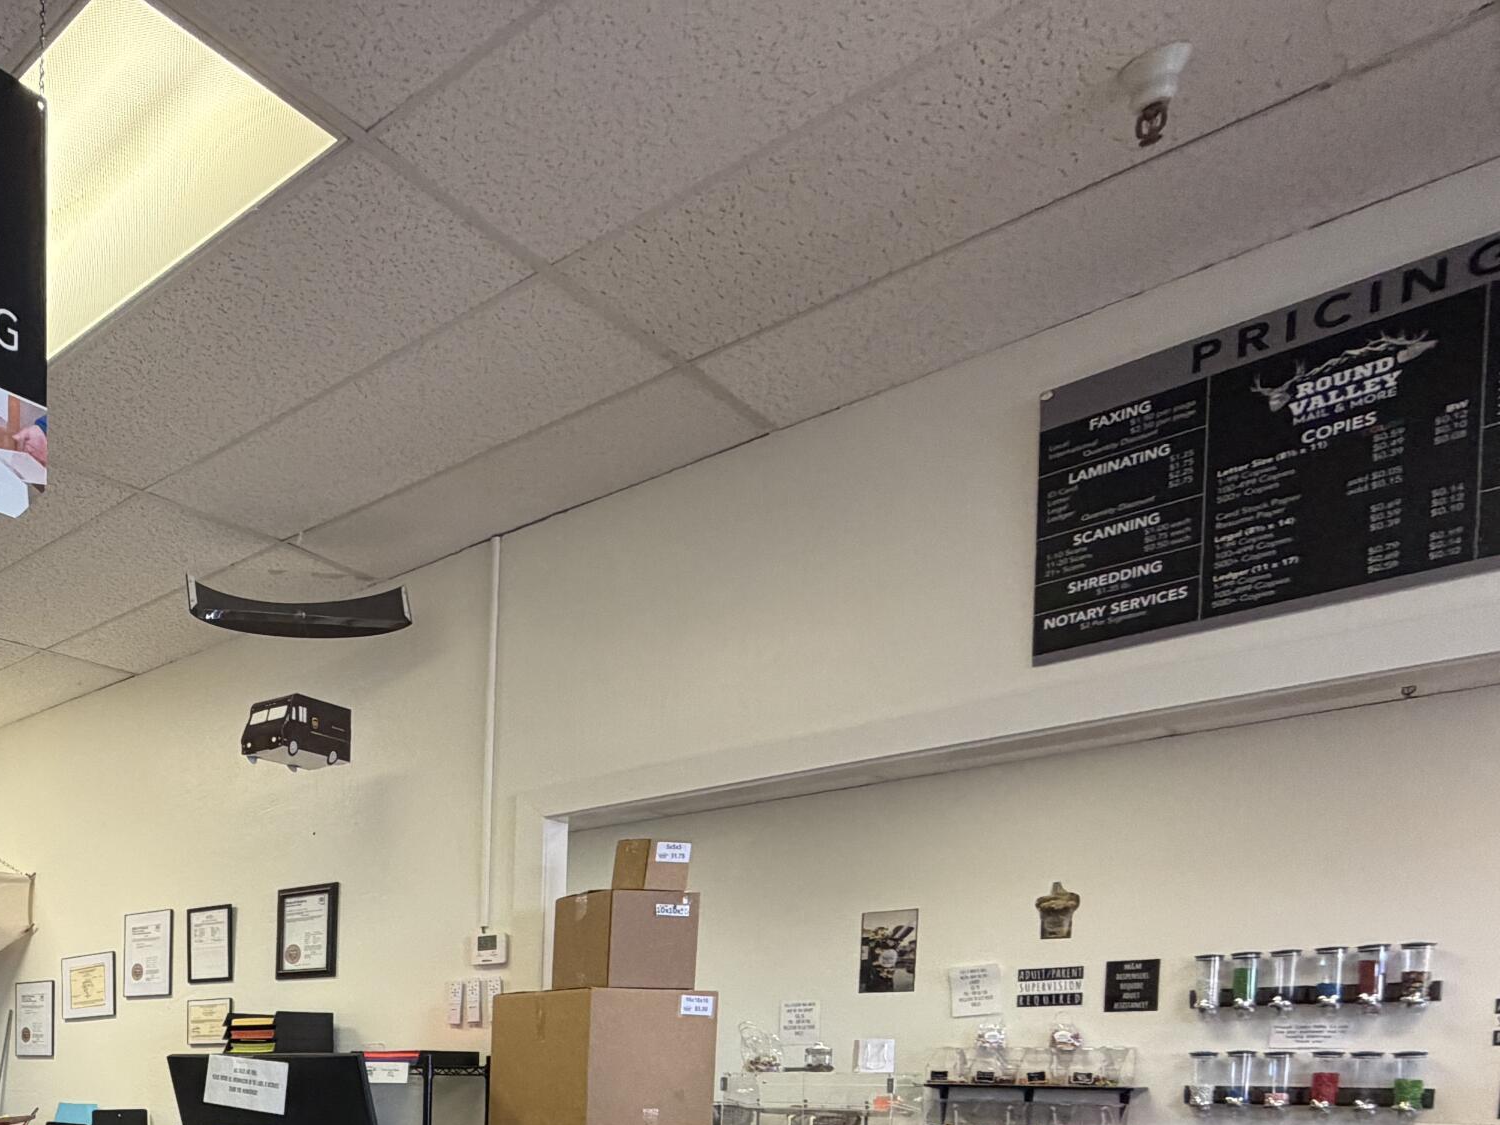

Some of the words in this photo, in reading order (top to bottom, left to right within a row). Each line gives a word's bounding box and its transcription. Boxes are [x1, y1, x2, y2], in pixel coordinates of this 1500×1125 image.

[1288, 370, 1403, 417] VALLEY
[1295, 357, 1396, 399] ROUND
[1350, 387, 1398, 410] MORE
[1088, 400, 1152, 432] FAXING
[1300, 411, 1378, 445] COPIES
[1068, 443, 1172, 485] LAMINATING
[1072, 512, 1162, 547] SCANNING
[1067, 560, 1164, 595] SHREDDING
[1043, 605, 1107, 630] NOTARY
[1109, 586, 1189, 616] SERVICES
[1018, 966, 1083, 981] ADULT/PARENT
[1019, 979, 1083, 993] SUPERVISION
[1017, 993, 1082, 1007] REQUIRED
